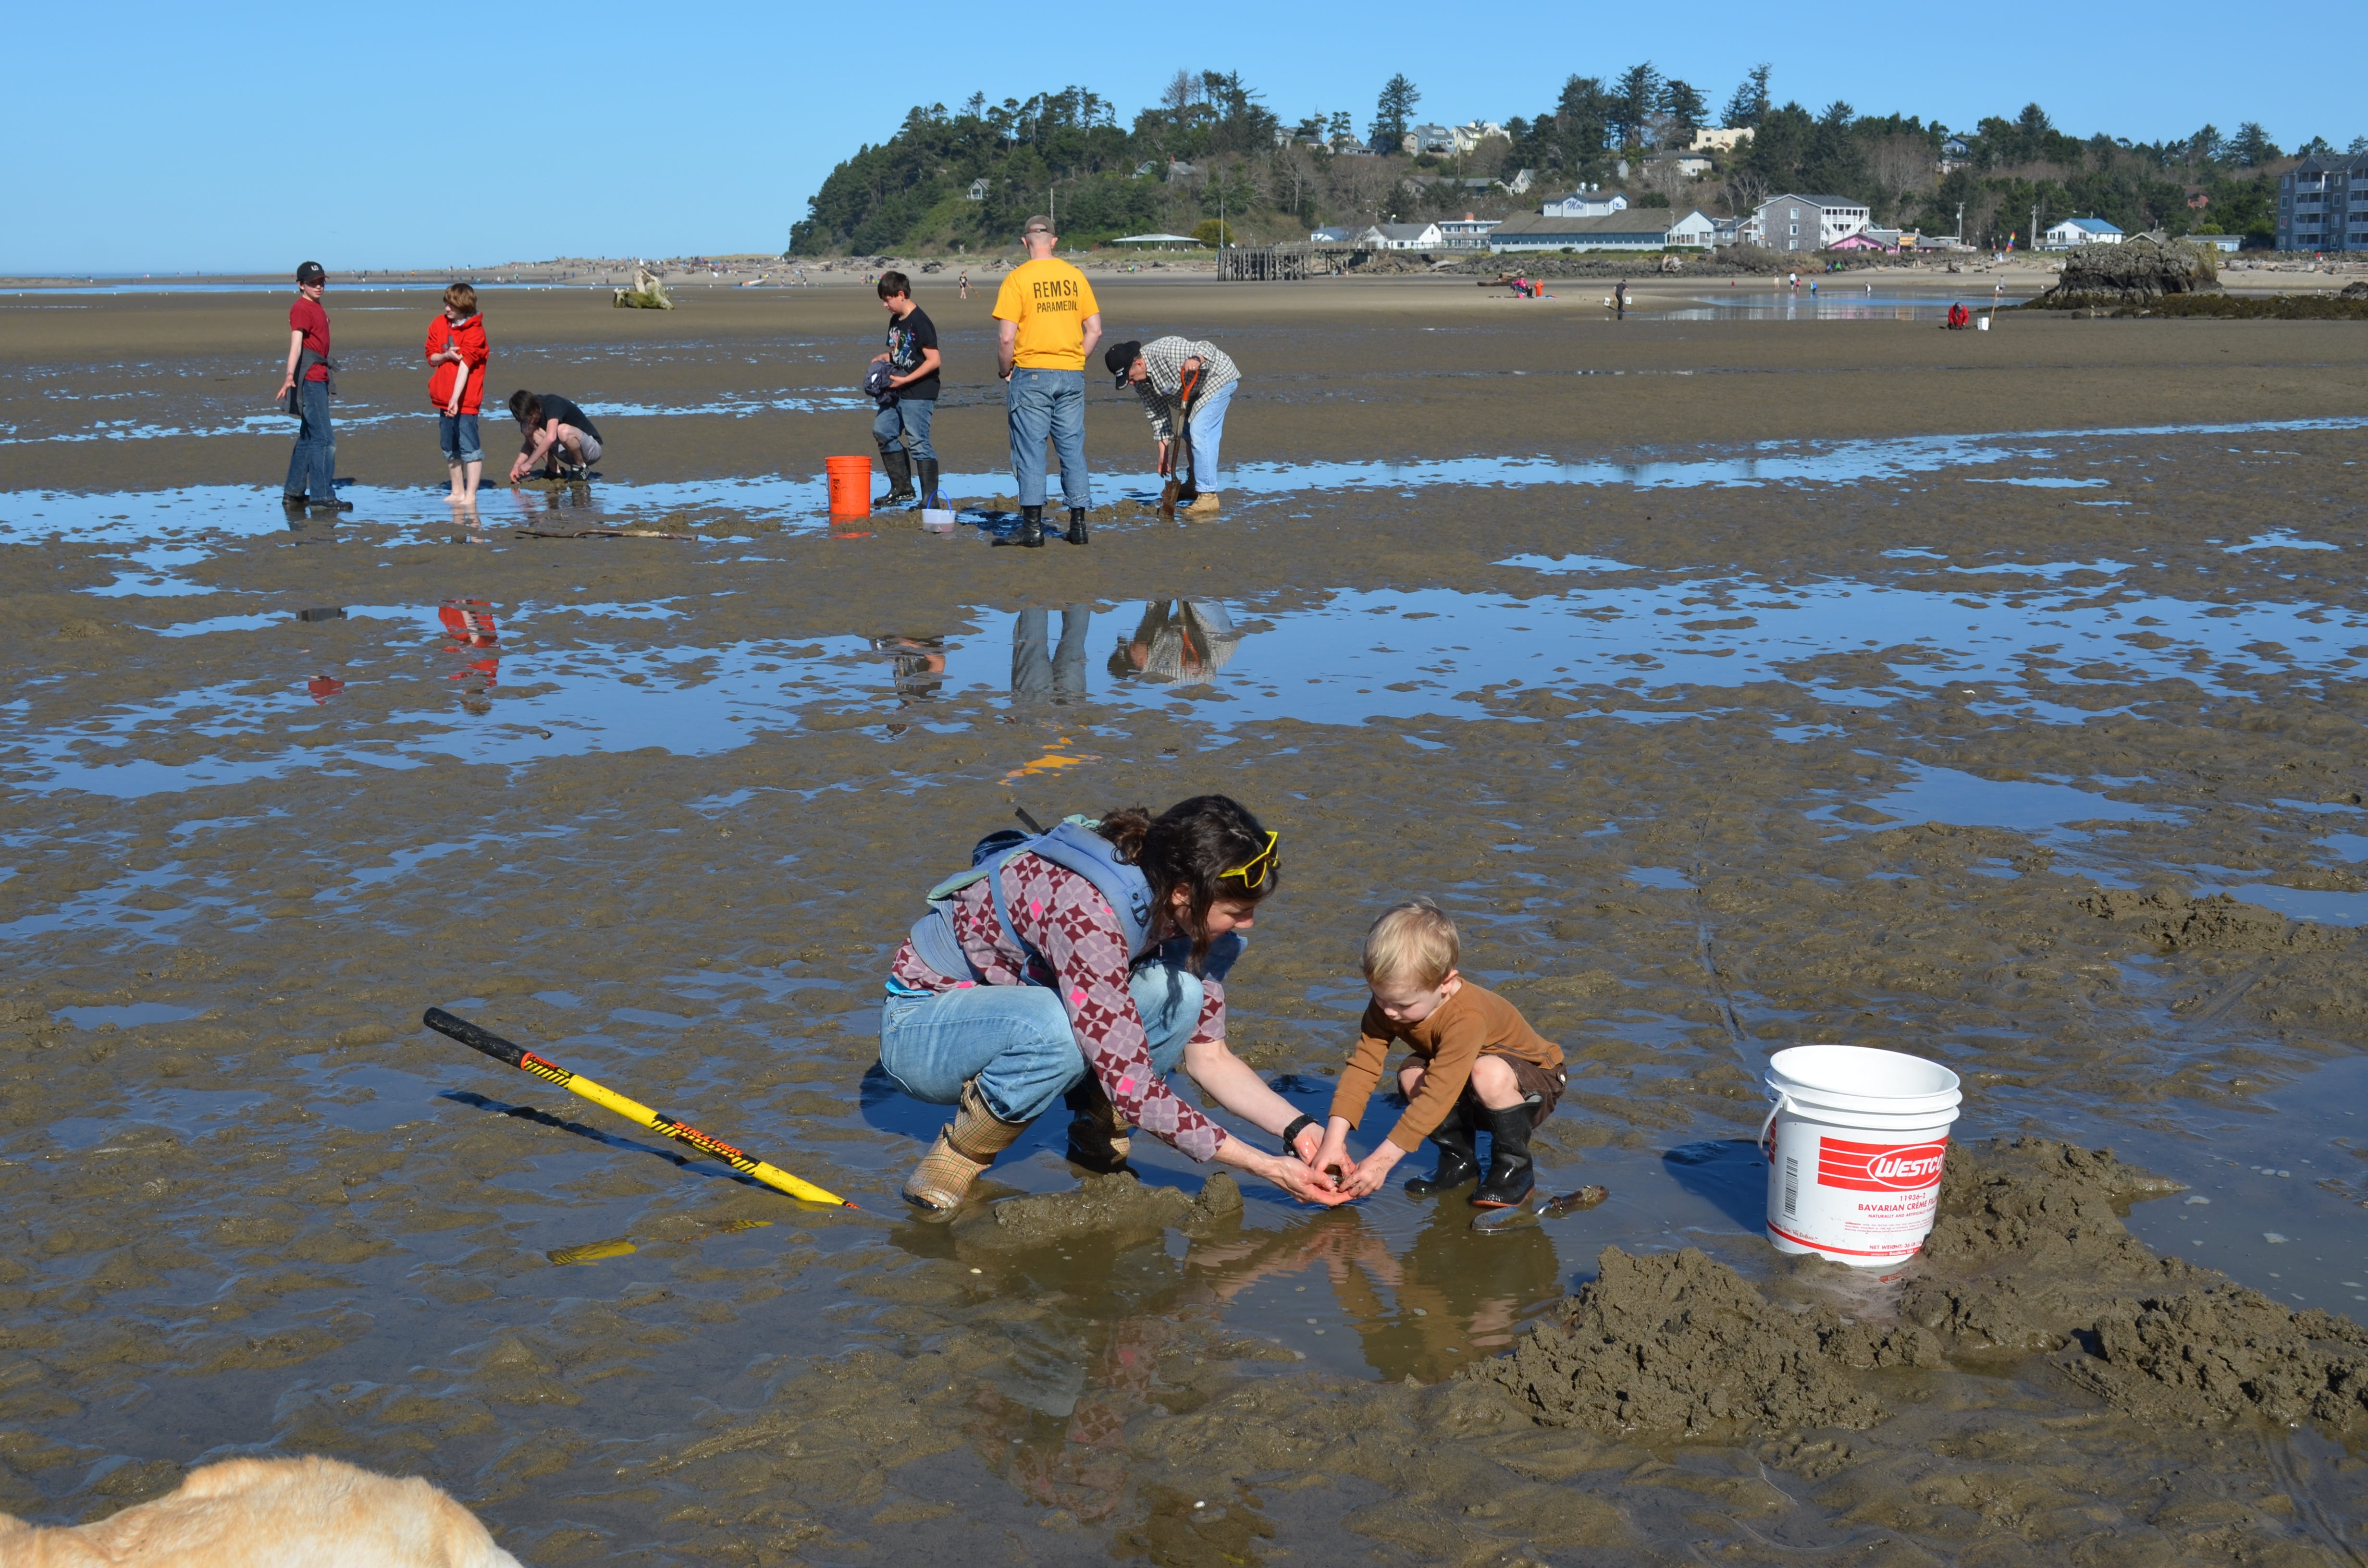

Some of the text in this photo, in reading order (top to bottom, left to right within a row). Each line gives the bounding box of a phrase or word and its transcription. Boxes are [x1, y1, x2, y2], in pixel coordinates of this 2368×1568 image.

[1033, 279, 1078, 299] REMSA
[1037, 300, 1078, 313] PARAMEDIC
[1875, 1153, 1943, 1177] WESTCO
[1900, 1192, 1926, 1201] 11936-2
[1858, 1203, 1905, 1212] BAVARIAN
[1907, 1200, 1927, 1210] CRÈME
